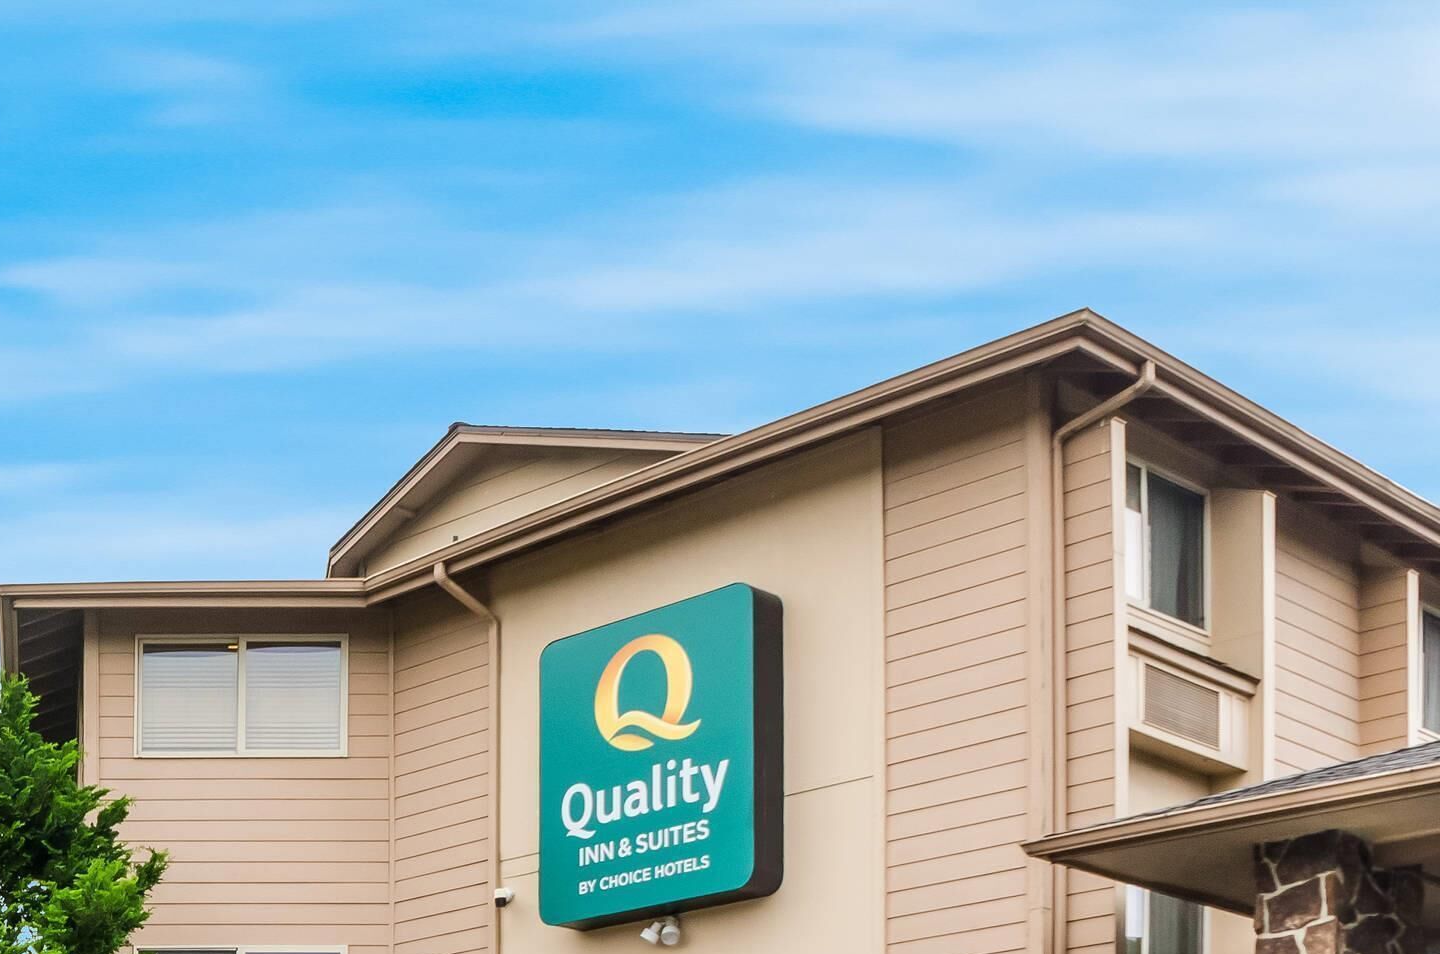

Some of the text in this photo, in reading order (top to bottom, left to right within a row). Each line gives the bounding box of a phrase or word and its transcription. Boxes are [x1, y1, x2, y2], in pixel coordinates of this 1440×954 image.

[561, 757, 730, 840] Quality
[578, 819, 710, 867] INN & SUITES
[578, 855, 710, 895] BY CHOICE HOTELS
